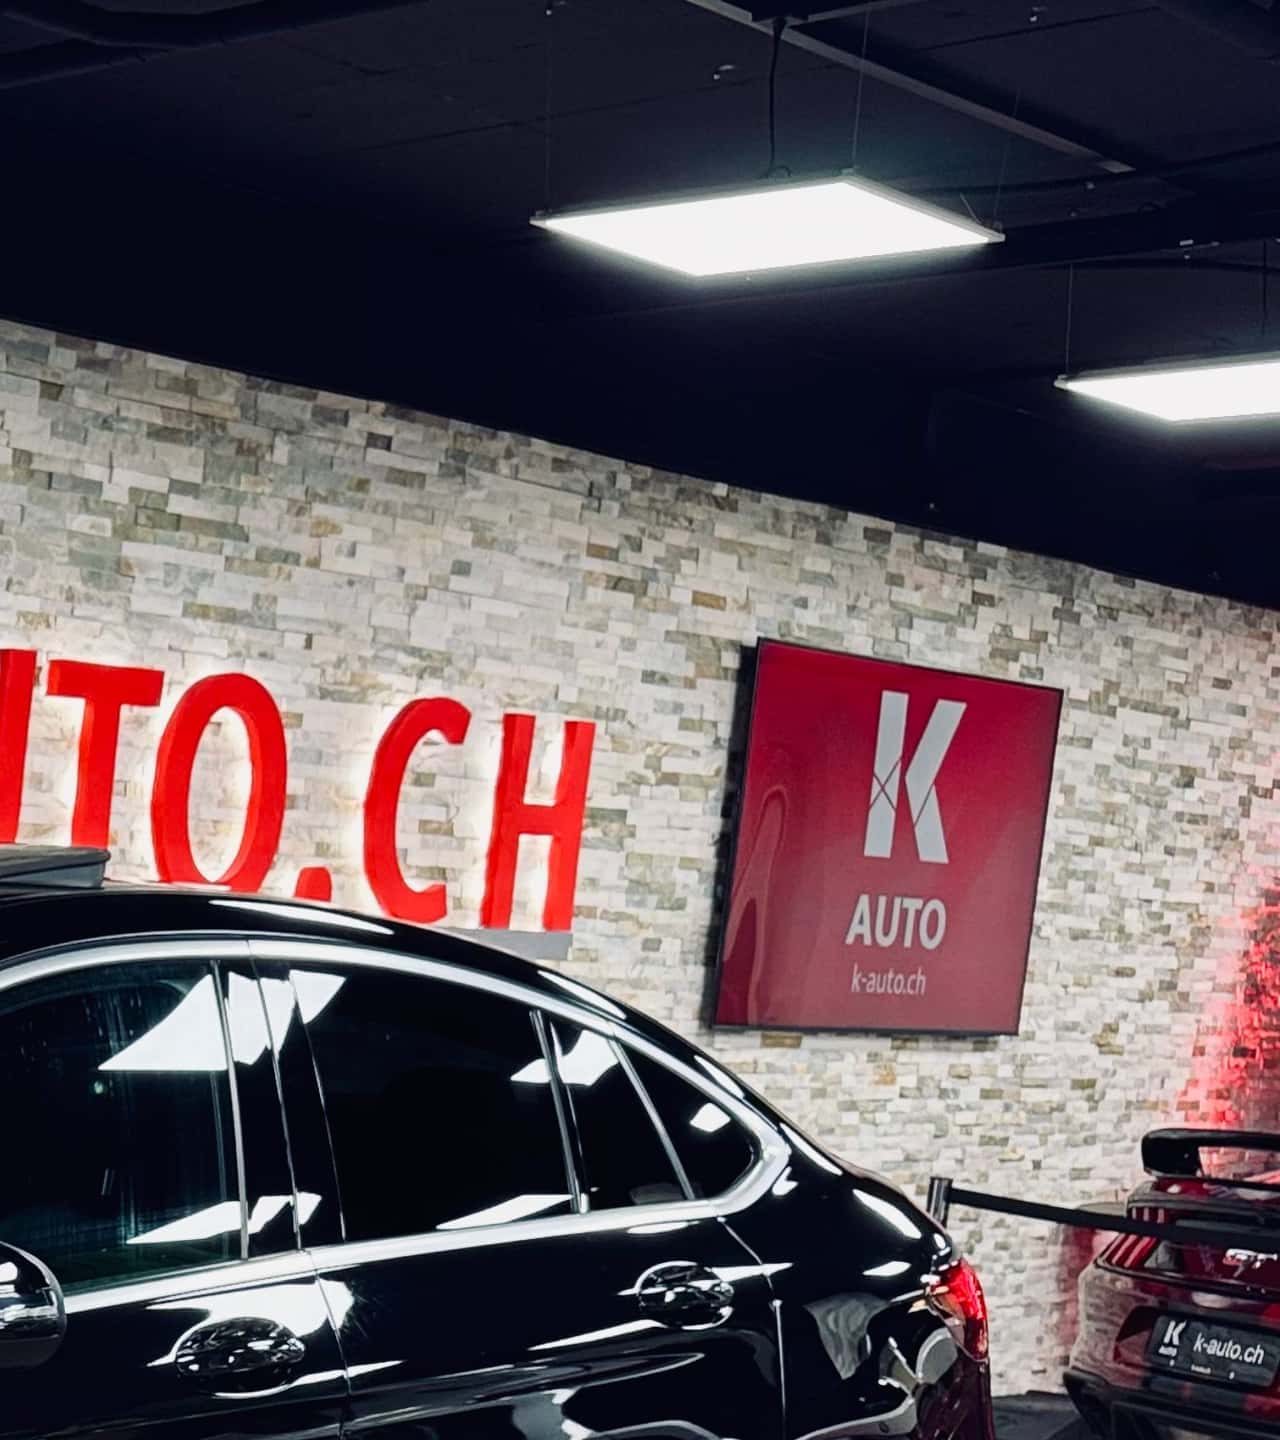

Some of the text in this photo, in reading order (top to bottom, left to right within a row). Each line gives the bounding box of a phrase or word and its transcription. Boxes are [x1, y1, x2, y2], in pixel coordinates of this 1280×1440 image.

[864, 690, 967, 864] K
[845, 893, 947, 951] AUTO
[850, 963, 927, 996] k-auto.ch
[1162, 1319, 1187, 1346] K
[1192, 1331, 1265, 1365] k-auto.ch
